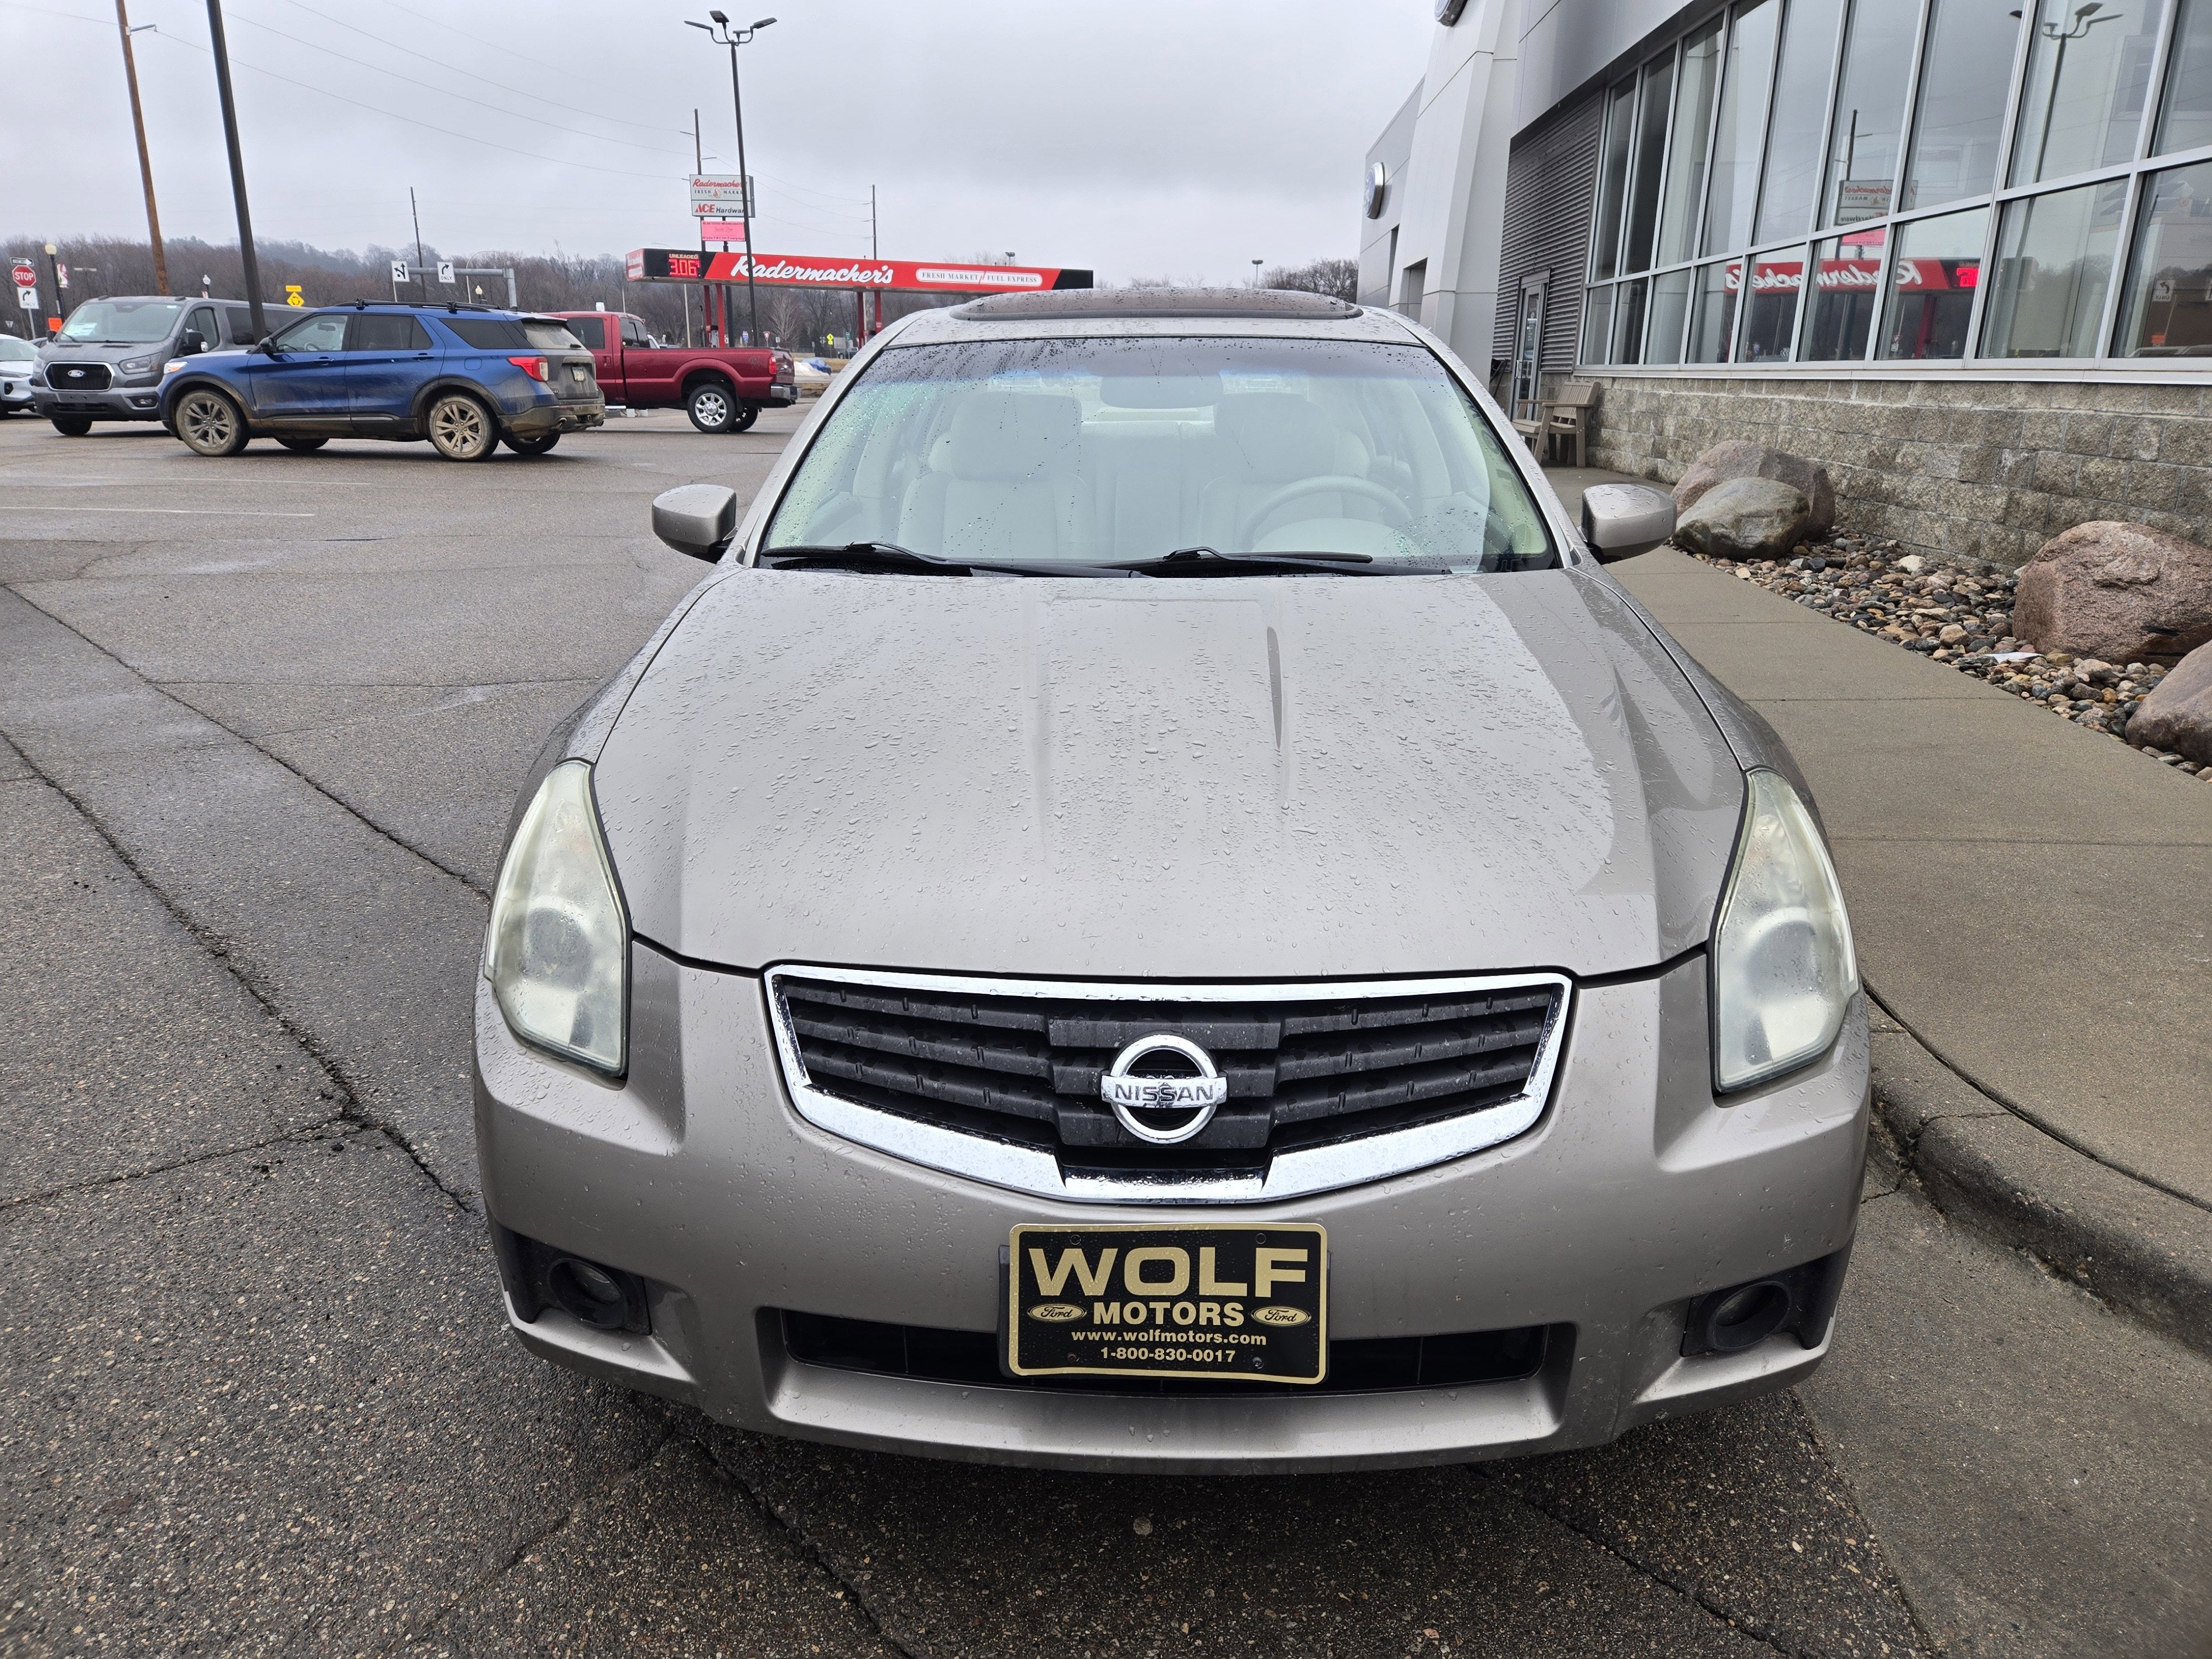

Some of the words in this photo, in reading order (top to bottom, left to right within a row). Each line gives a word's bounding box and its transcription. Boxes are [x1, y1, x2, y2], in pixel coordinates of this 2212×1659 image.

[693, 179, 742, 187] Radermache
[695, 202, 716, 213] ACE
[14, 271, 34, 281] STOP
[731, 255, 894, 284] Radermacher's
[1115, 1083, 1213, 1102] NISSAN
[1028, 1246, 1308, 1298] WOLF
[1040, 1306, 1073, 1318] Ford
[1093, 1301, 1244, 1327] MOTORS
[1264, 1309, 1297, 1322] Ford
[1071, 1329, 1266, 1345] www.wolfmotors.com
[1100, 1347, 1236, 1363] 1-800-830-0017
